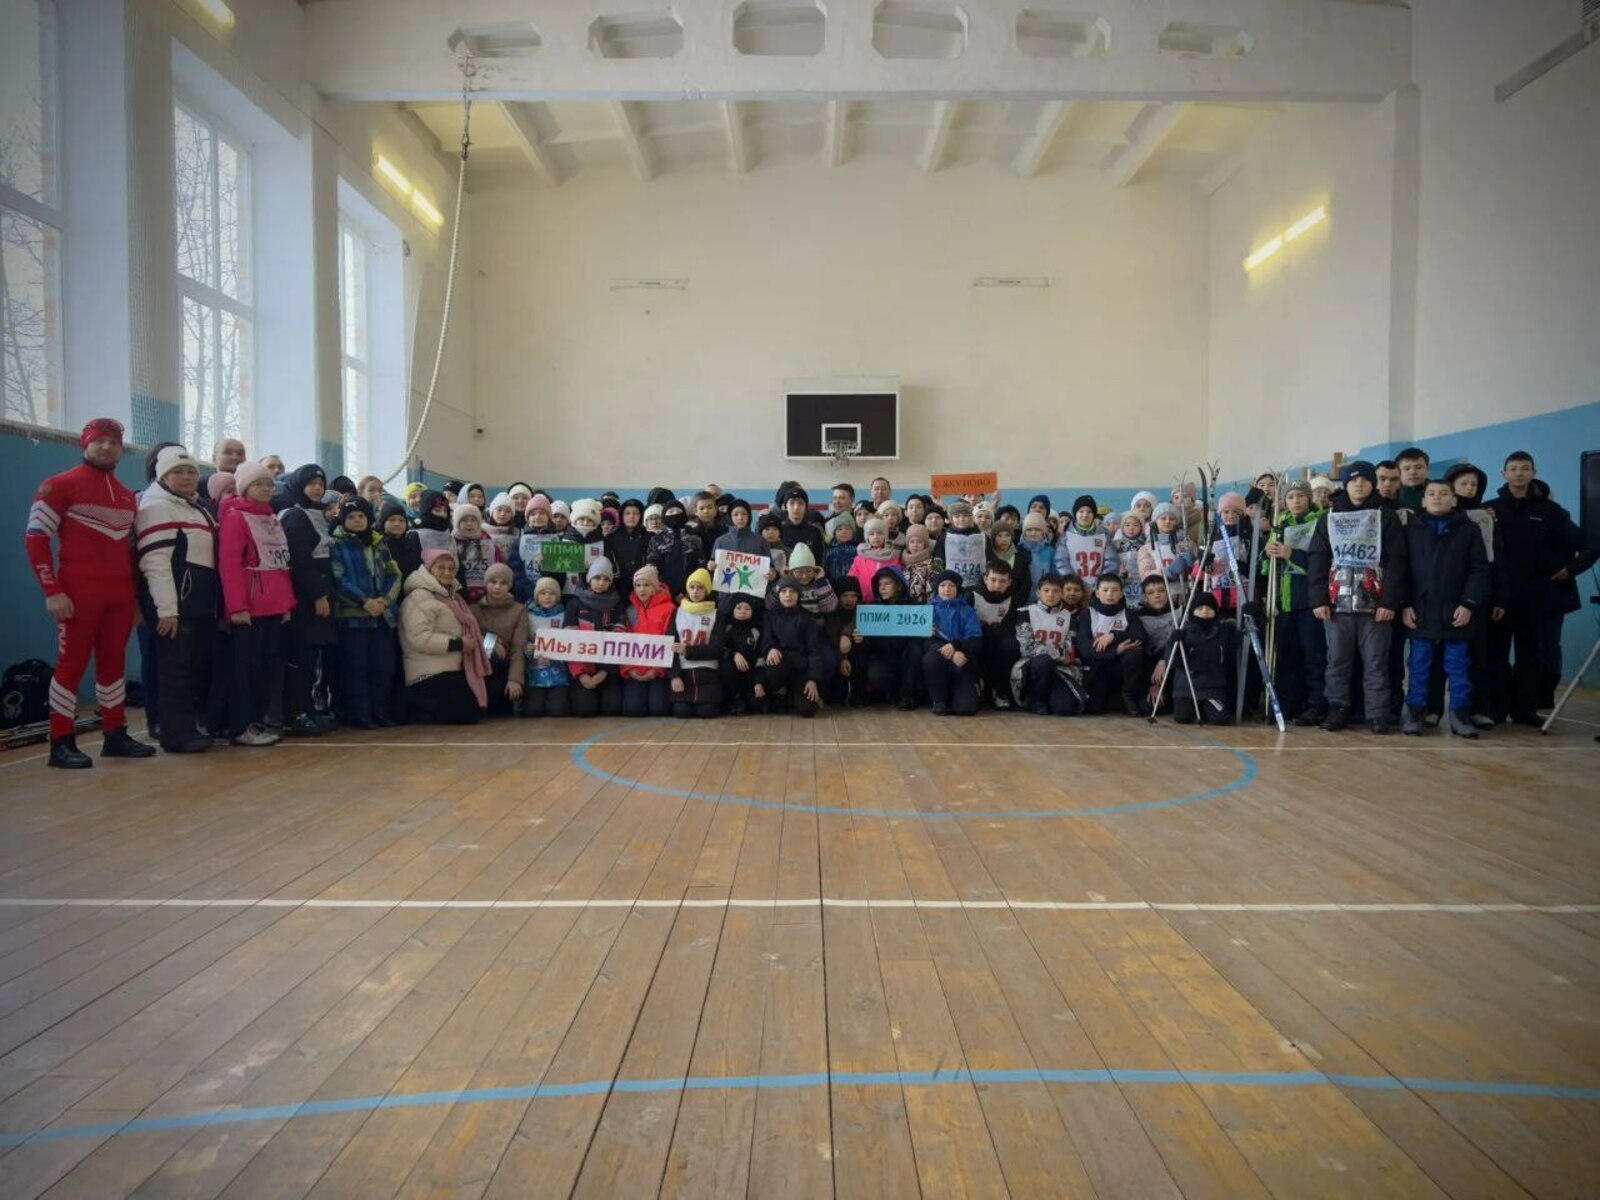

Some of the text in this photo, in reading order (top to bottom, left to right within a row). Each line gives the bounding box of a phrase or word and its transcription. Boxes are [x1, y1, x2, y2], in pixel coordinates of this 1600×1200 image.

[543, 544, 583, 554] ППМИ
[1334, 543, 1377, 561] 1/462
[726, 551, 761, 566] ППМИ
[1075, 551, 1102, 578] 32
[954, 562, 981, 576] 5424
[860, 611, 927, 625] ППМИ 2026
[536, 637, 665, 660] Мы за ППМИ
